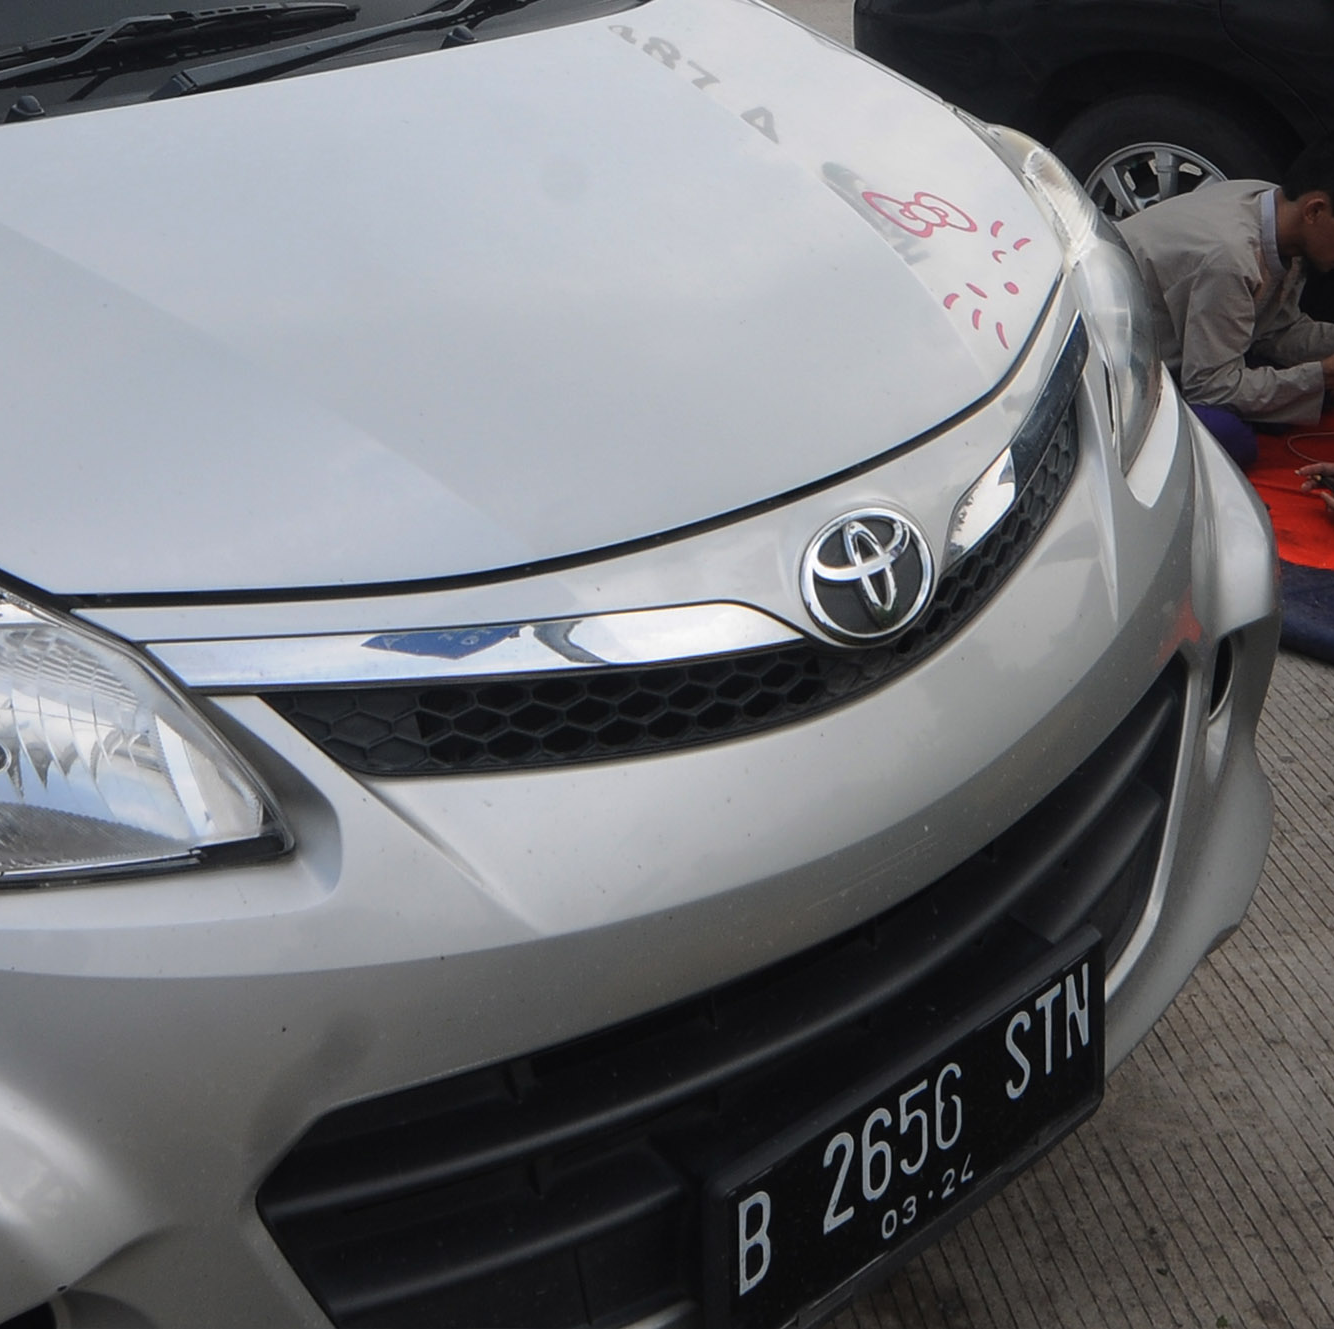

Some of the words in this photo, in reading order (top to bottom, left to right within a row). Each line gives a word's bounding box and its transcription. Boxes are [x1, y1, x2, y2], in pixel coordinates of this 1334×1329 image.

[738, 1190, 772, 1297] B
[822, 1061, 963, 1236] 2656
[1004, 962, 1091, 1101] STN
